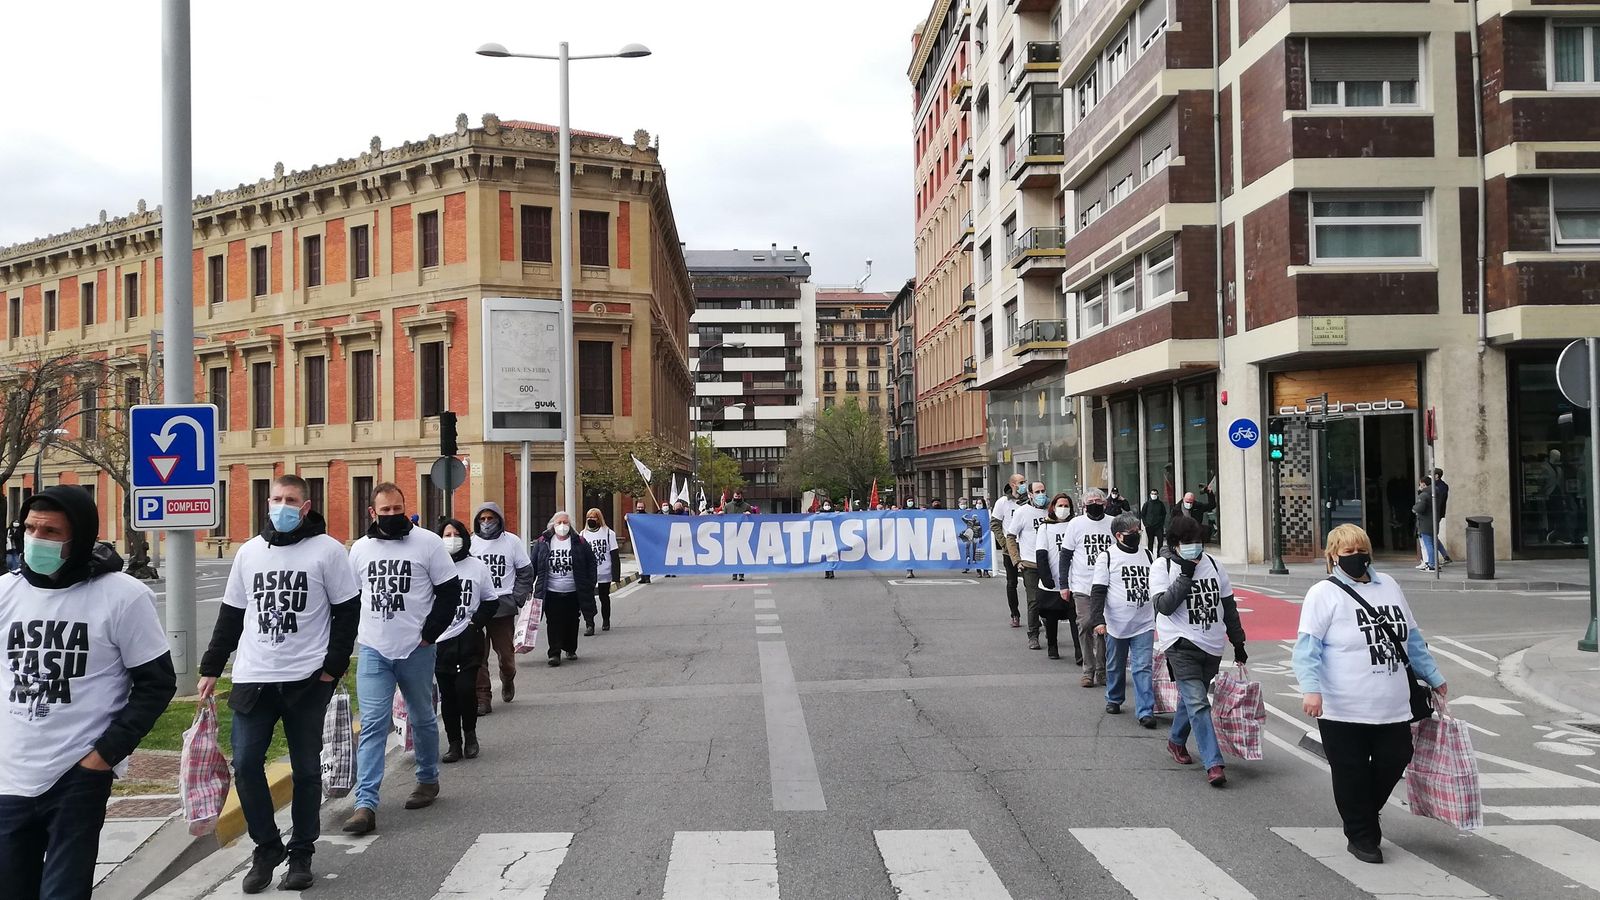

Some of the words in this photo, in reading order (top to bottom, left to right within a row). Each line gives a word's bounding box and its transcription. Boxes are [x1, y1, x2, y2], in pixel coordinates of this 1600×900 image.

[519, 385, 534, 393] 600
[143, 498, 159, 519] P
[168, 501, 210, 512] COMPLETO
[664, 517, 961, 566] ASKATASUNA
[1084, 534, 1112, 544] ASKA
[367, 560, 412, 577] ASKA
[253, 570, 308, 592] ASKA
[368, 577, 411, 593] TASU
[254, 591, 307, 612] TASU
[1186, 593, 1220, 609] TASU
[7, 620, 89, 651] ASKA
[7, 651, 88, 680] TASU
